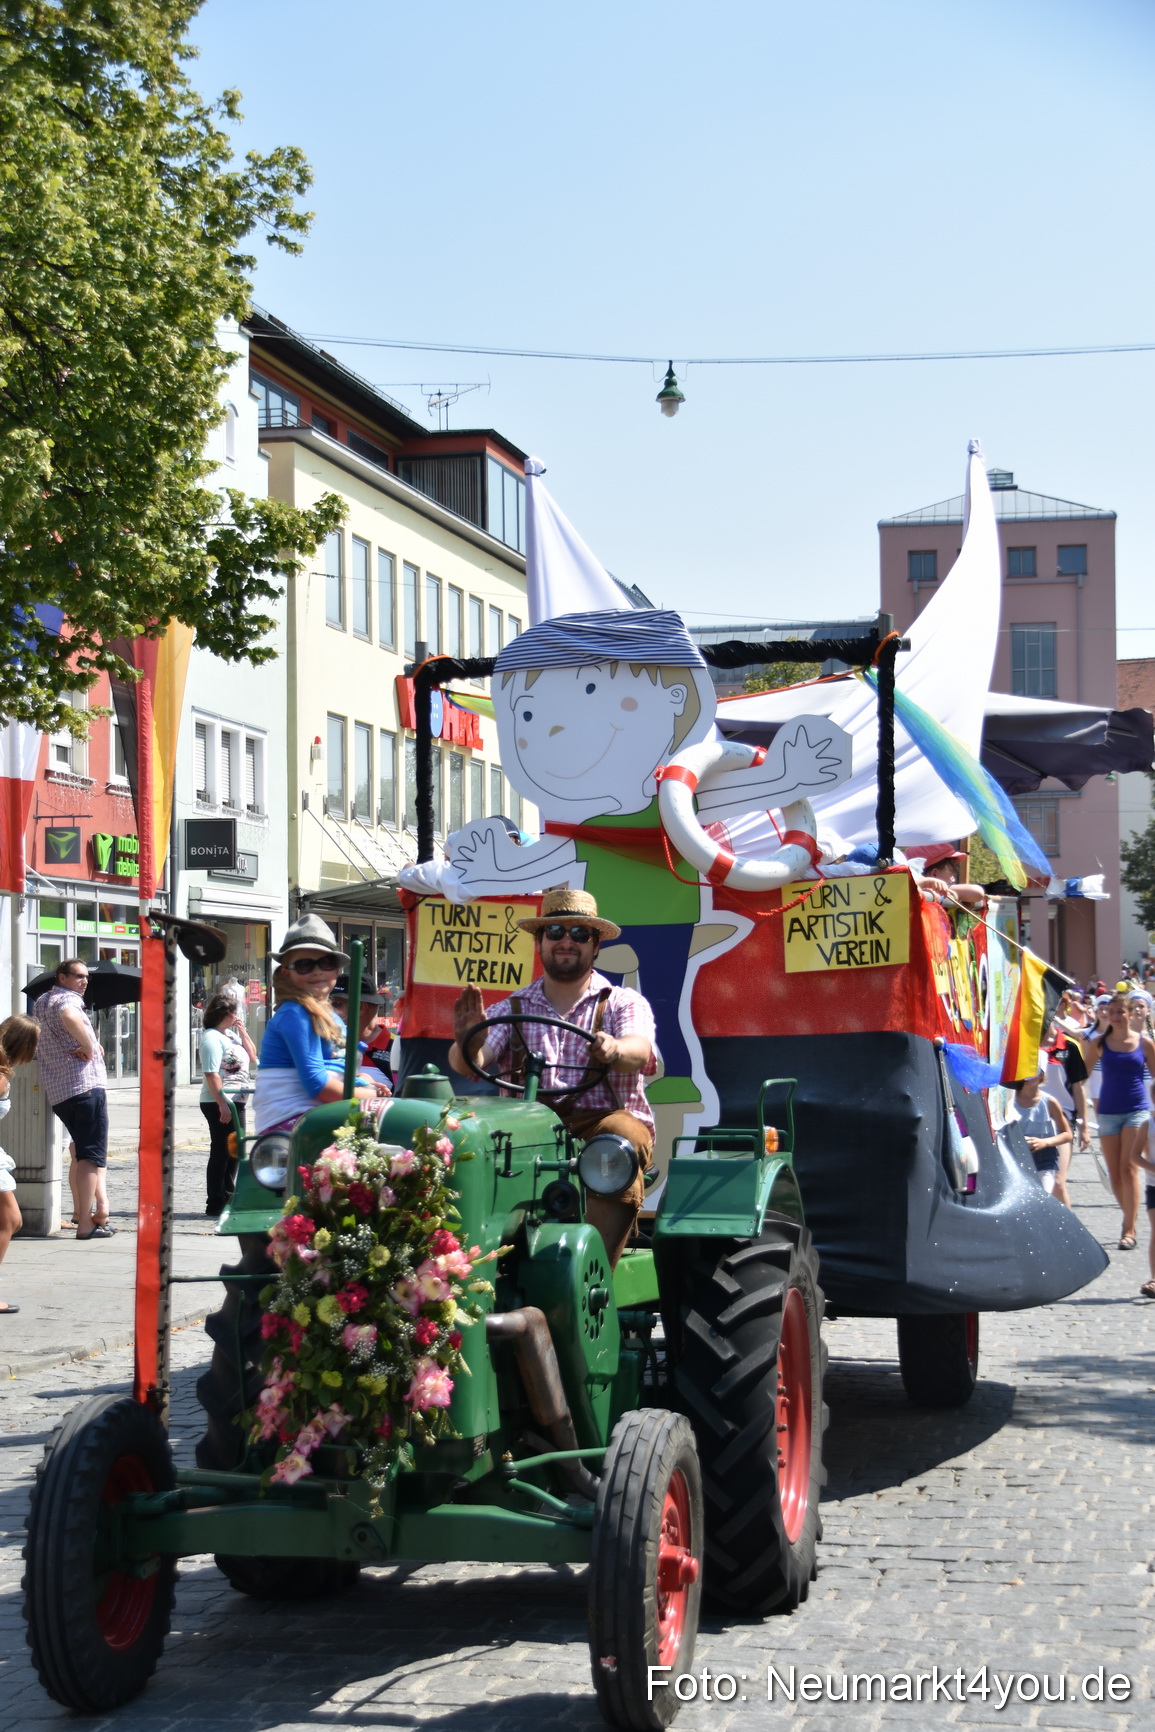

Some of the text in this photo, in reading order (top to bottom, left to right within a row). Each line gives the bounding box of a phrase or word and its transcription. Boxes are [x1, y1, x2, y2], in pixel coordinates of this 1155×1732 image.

[190, 845, 229, 857] BONITA
[873, 877, 892, 906] &
[505, 905, 520, 933] &
[787, 911, 885, 943] ARTISTIK
[429, 930, 518, 954] ARTISTIK
[816, 938, 890, 966] VEREIN
[453, 957, 523, 985] VEREIN
